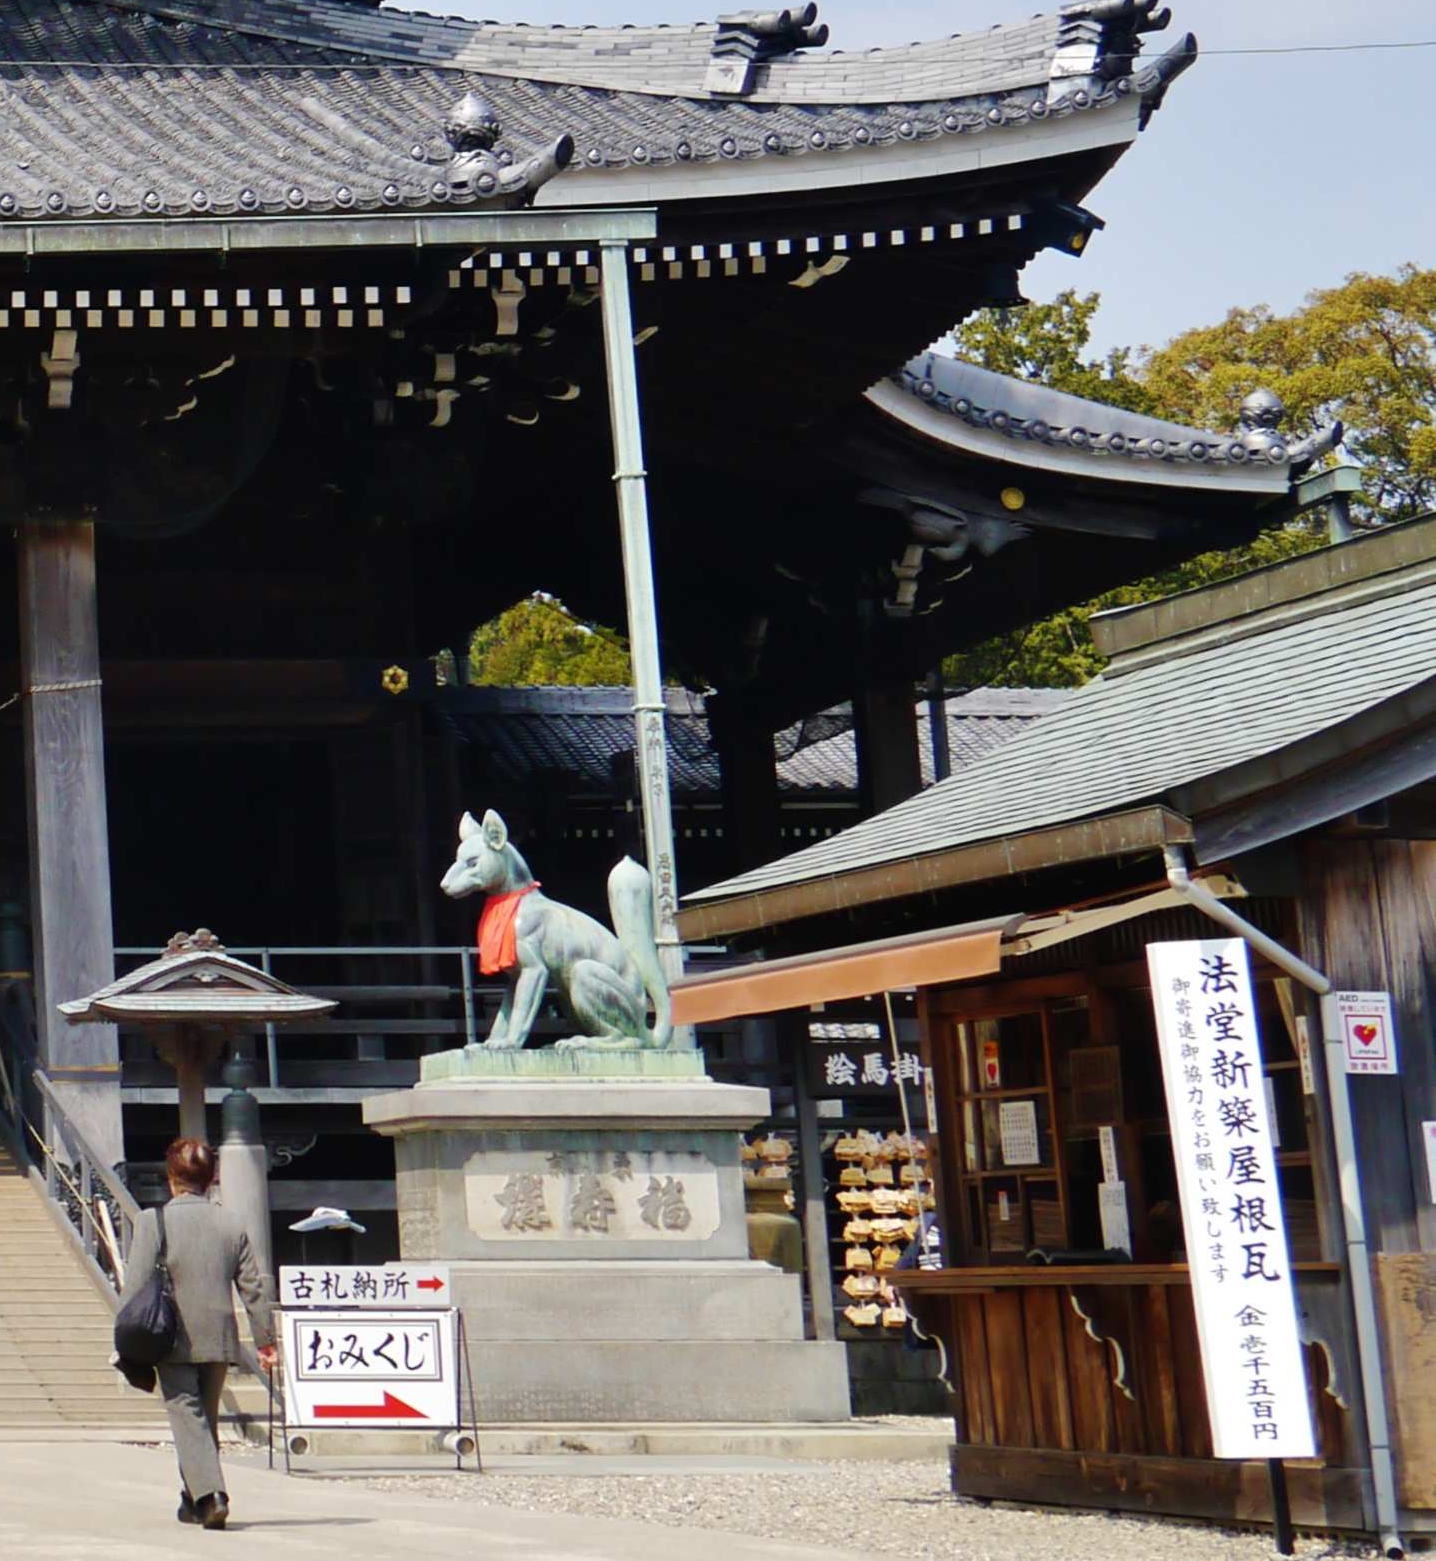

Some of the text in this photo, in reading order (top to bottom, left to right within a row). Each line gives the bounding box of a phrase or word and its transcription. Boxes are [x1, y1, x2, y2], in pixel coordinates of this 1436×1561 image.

[1339, 994, 1359, 1003] AED
[1172, 978, 1229, 1283] 御寄進御協力をお願い致します
[1198, 954, 1281, 1282] 法堂新築屋根瓦
[288, 1270, 410, 1301] 古札納所
[308, 1329, 429, 1371] おみくじ
